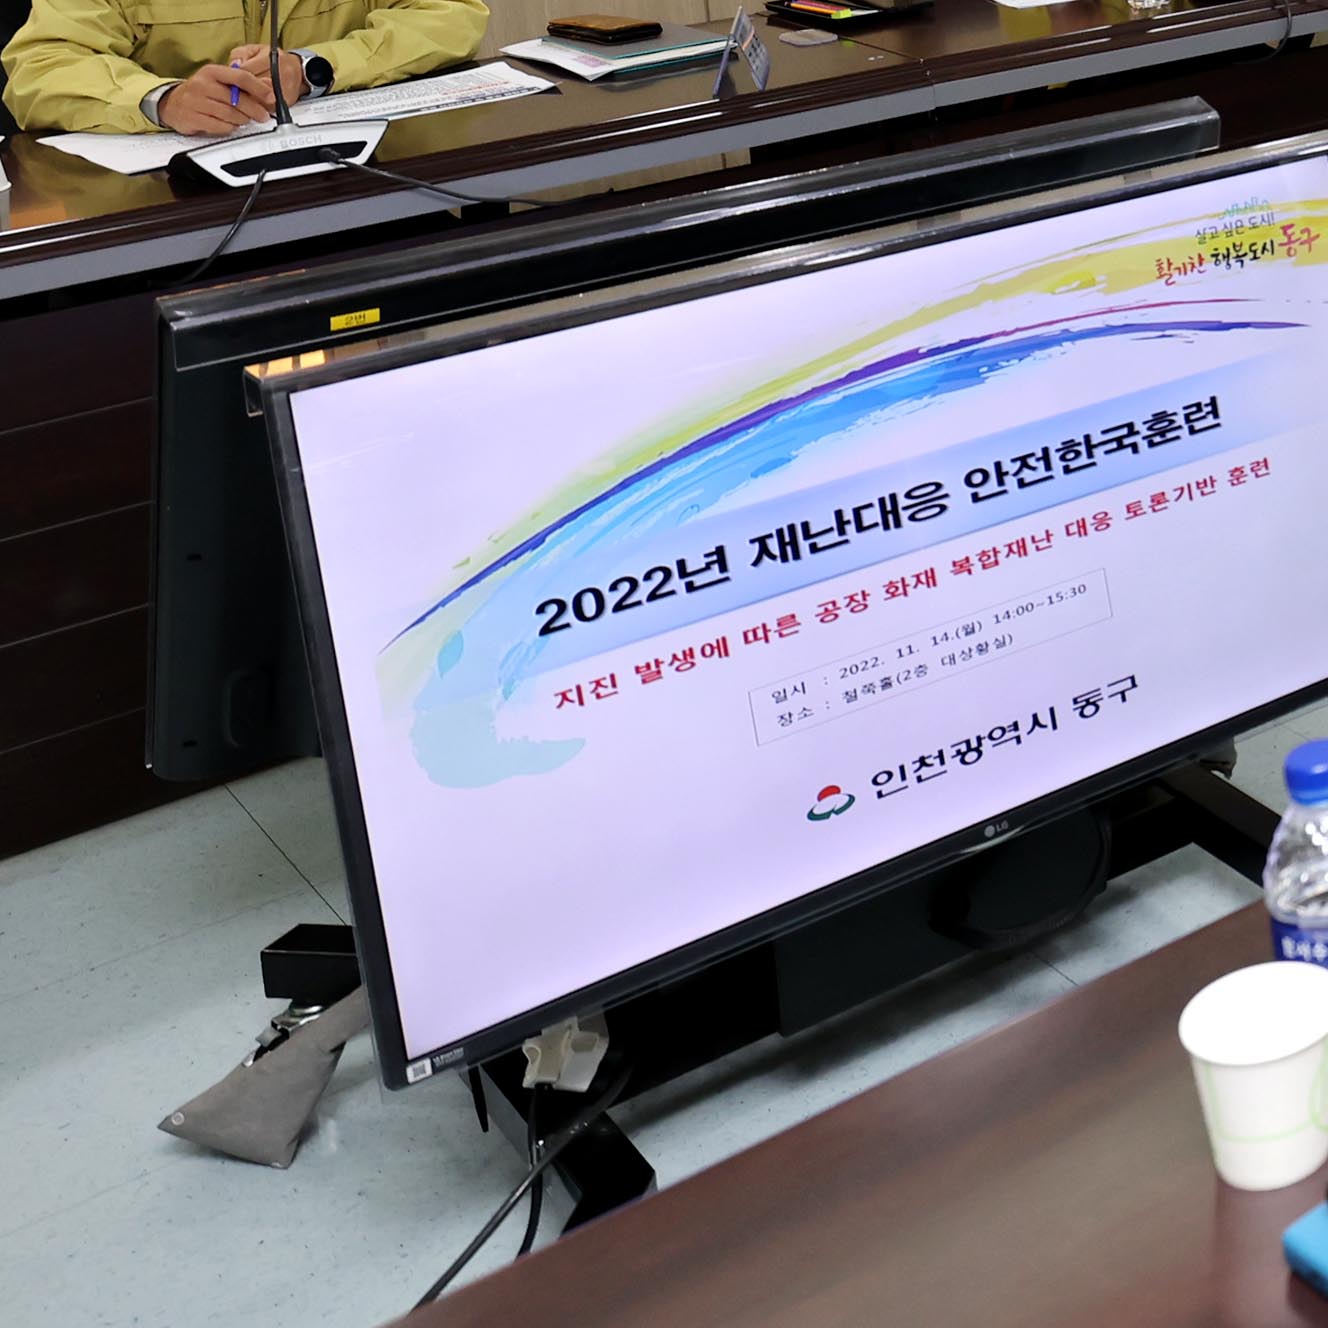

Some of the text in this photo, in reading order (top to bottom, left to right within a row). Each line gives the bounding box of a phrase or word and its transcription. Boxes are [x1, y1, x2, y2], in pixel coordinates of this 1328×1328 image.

[1155, 223, 1321, 286] 활기찬 행복도시 동구
[534, 395, 1223, 638] 2022년 재난대응 안전한국훈련
[554, 456, 1271, 710] 지진 발생에 따른 공장 화재 복합재난 대응 토론기반 훈련
[771, 680, 807, 706] 일시
[838, 659, 886, 682] 2022.
[991, 583, 1088, 626] 14:00~15:30
[776, 705, 816, 729] 장소
[870, 674, 1140, 801] 인천광역시 동구
